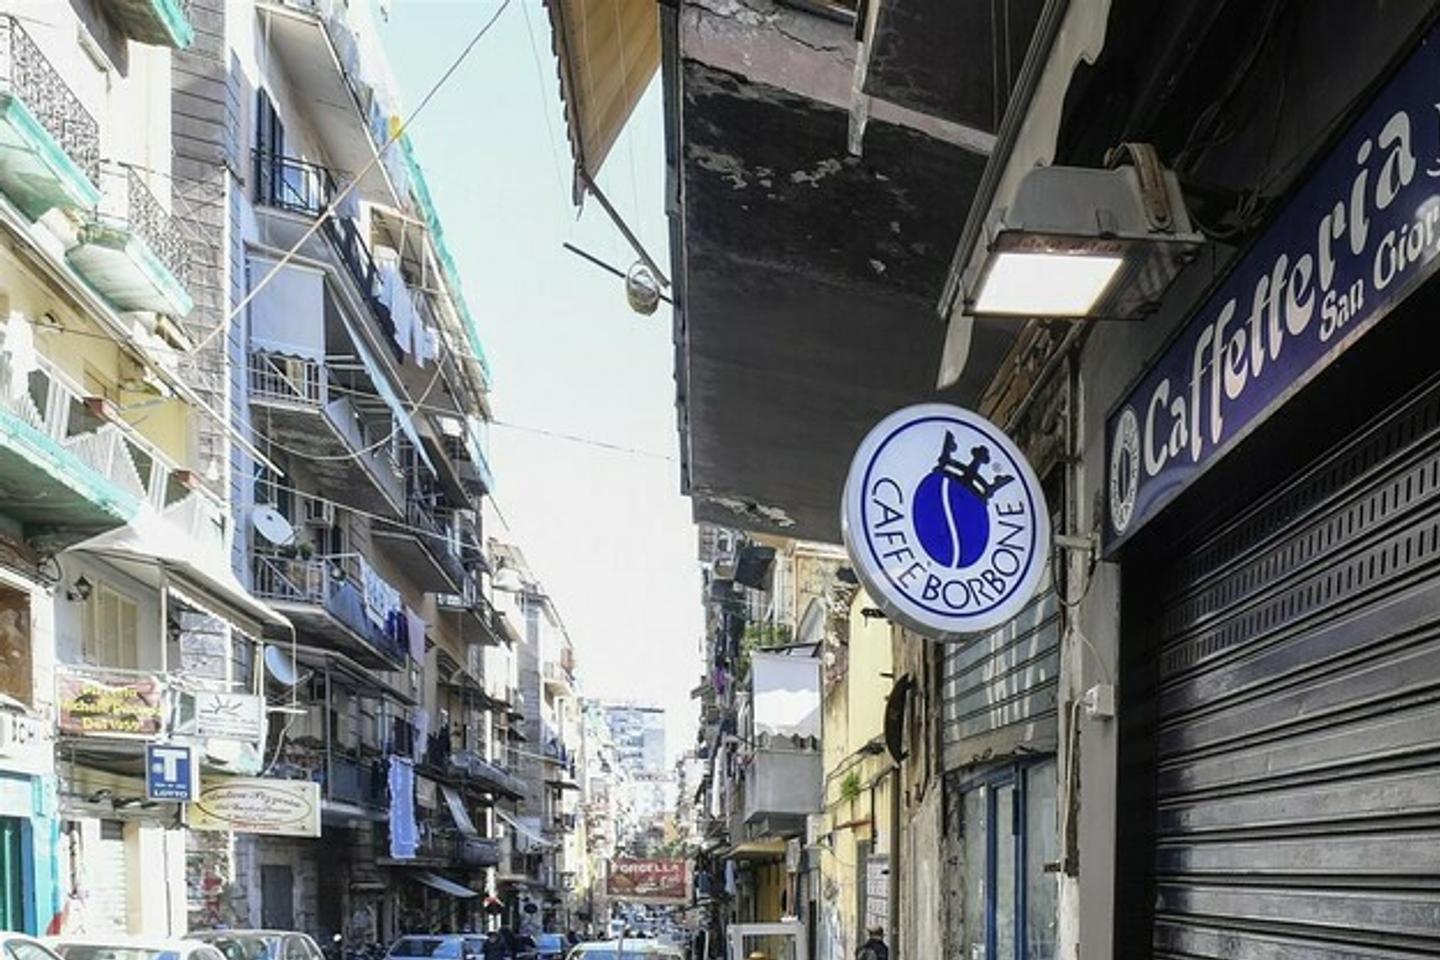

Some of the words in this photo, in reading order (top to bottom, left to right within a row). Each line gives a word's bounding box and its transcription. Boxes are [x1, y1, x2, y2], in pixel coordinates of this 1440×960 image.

[1144, 110, 1417, 476] Caffetteria
[1319, 278, 1364, 342] San
[922, 501, 1025, 609] BORBONE
[153, 749, 187, 782] T
[154, 790, 188, 800] LOTTO
